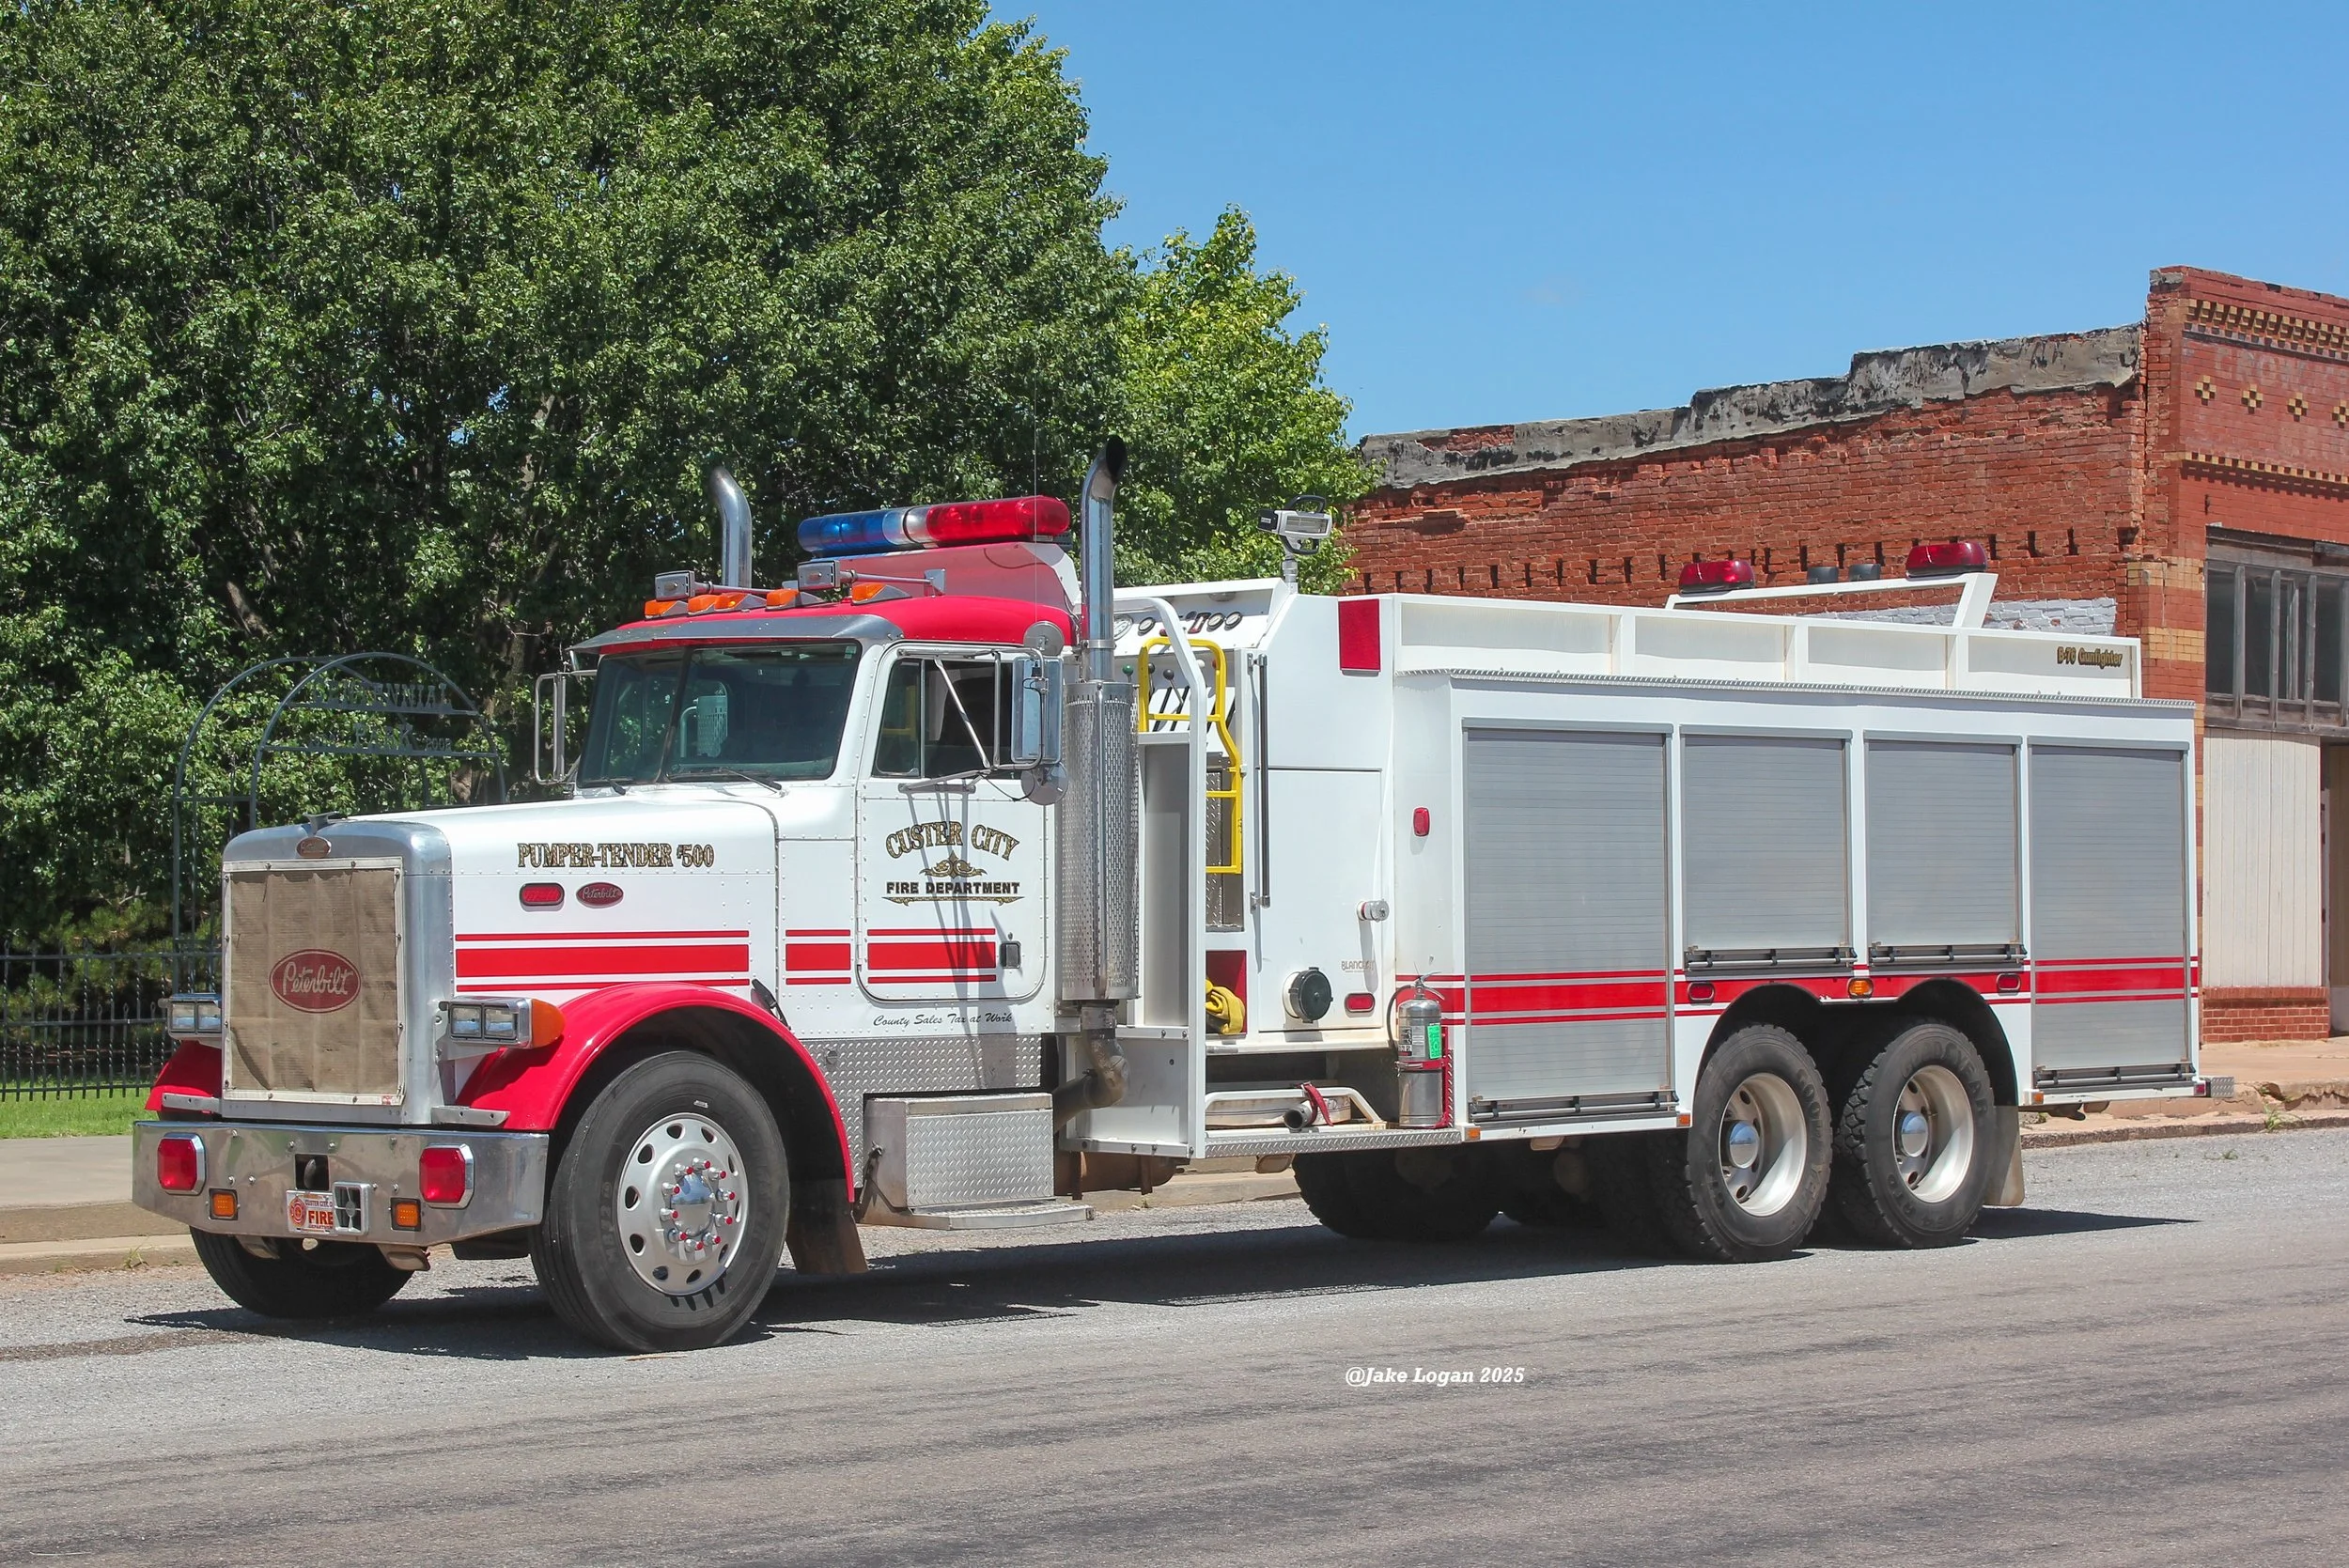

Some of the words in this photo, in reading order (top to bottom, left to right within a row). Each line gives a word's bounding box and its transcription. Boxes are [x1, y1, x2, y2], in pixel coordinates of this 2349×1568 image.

[2078, 647, 2123, 669] Gunfighter
[885, 821, 963, 860] CUSTER
[971, 824, 1020, 861] CITY
[518, 843, 674, 868] PUMPER-TENDER
[582, 886, 618, 900] Peterbilt
[886, 881, 919, 895] FIRE
[926, 881, 1020, 895] DEPARTMENT
[282, 961, 354, 997] Peterbilt
[873, 1015, 910, 1028] County
[914, 1014, 943, 1026] Sales
[947, 1013, 966, 1024] Tax
[969, 1015, 982, 1024] at
[985, 1012, 1014, 1023] Work
[308, 1210, 334, 1225] FIRE
